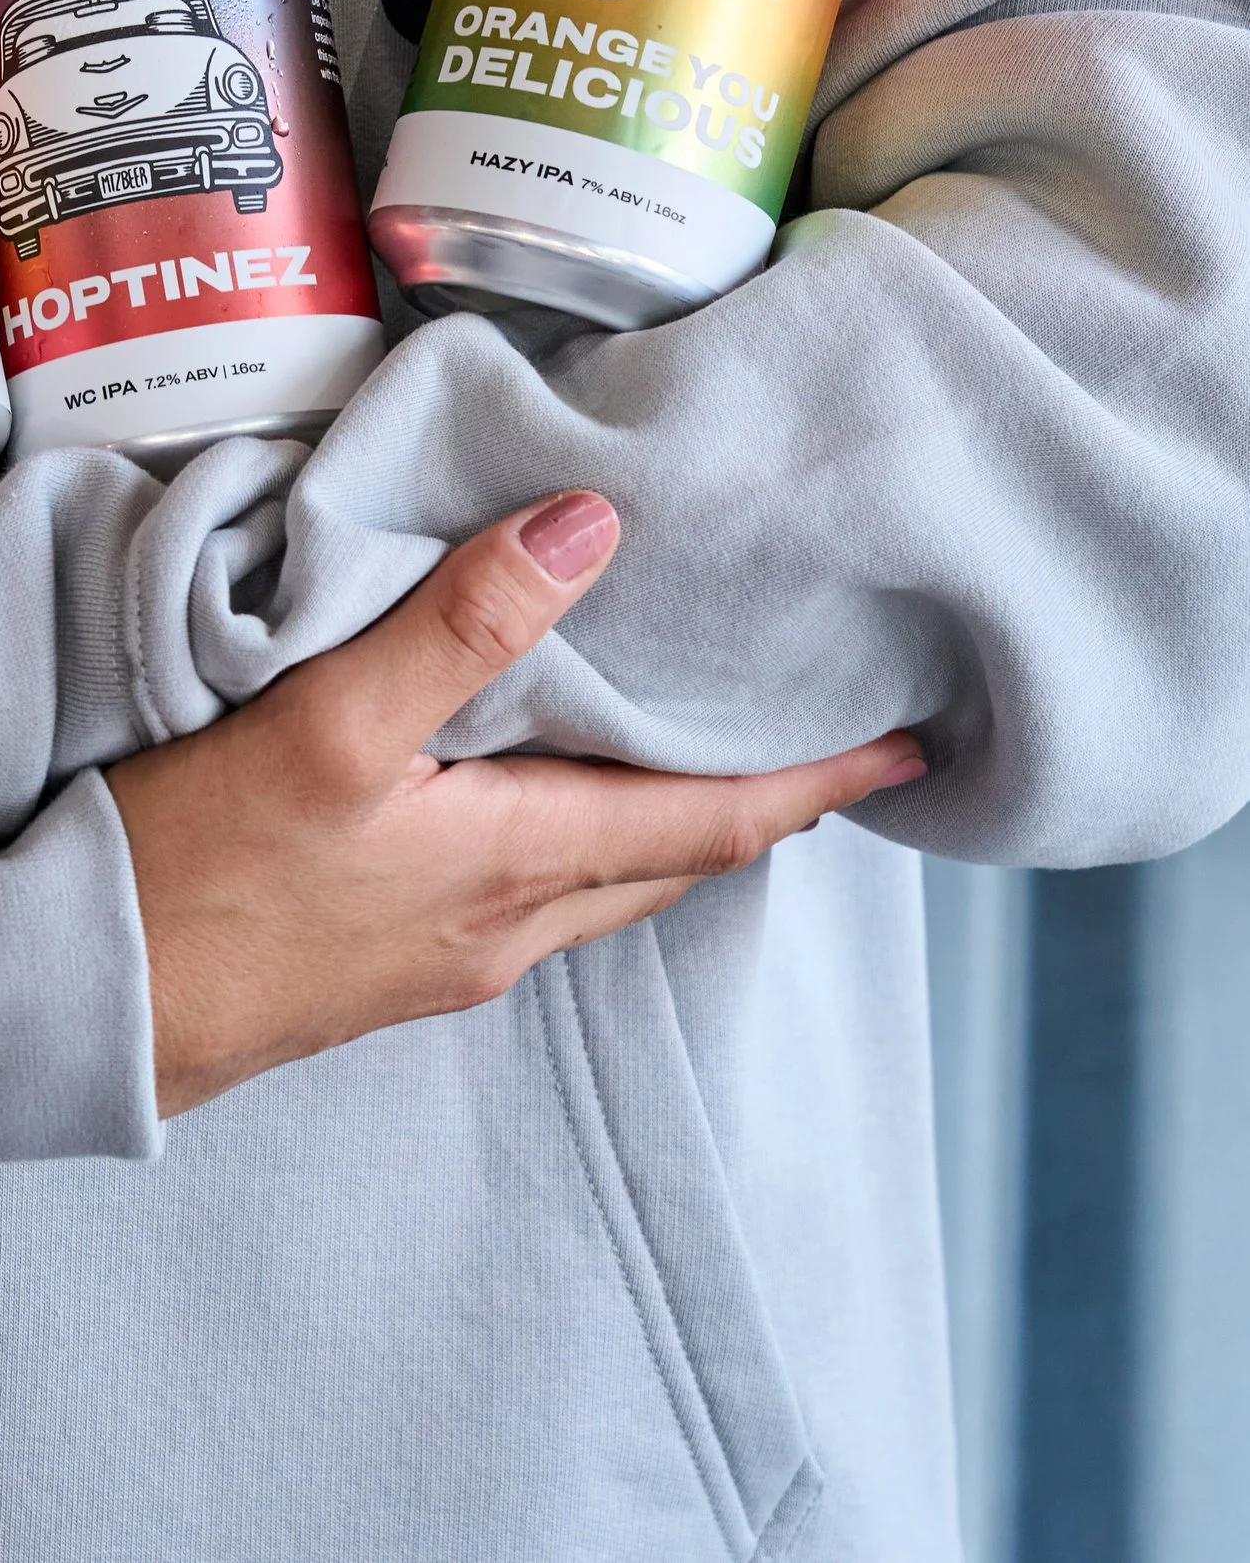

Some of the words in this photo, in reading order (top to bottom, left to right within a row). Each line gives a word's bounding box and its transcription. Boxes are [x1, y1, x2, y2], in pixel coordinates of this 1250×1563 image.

[437, 44, 767, 170] DELICIOUS
[453, 5, 679, 78] ORANGE
[687, 53, 780, 123] YOU
[101, 167, 148, 194] MTZBEER
[470, 151, 534, 174] HAZY
[536, 163, 574, 186] IPA
[581, 178, 604, 195] 7%
[608, 187, 643, 206] ABV
[653, 203, 687, 225] 16oz
[2, 245, 317, 346] HOPTINEZ
[64, 389, 97, 410] WC
[101, 380, 138, 400] IPA
[144, 373, 181, 391] 7.2%
[185, 366, 218, 383] ABV
[231, 362, 266, 376] 16oz
